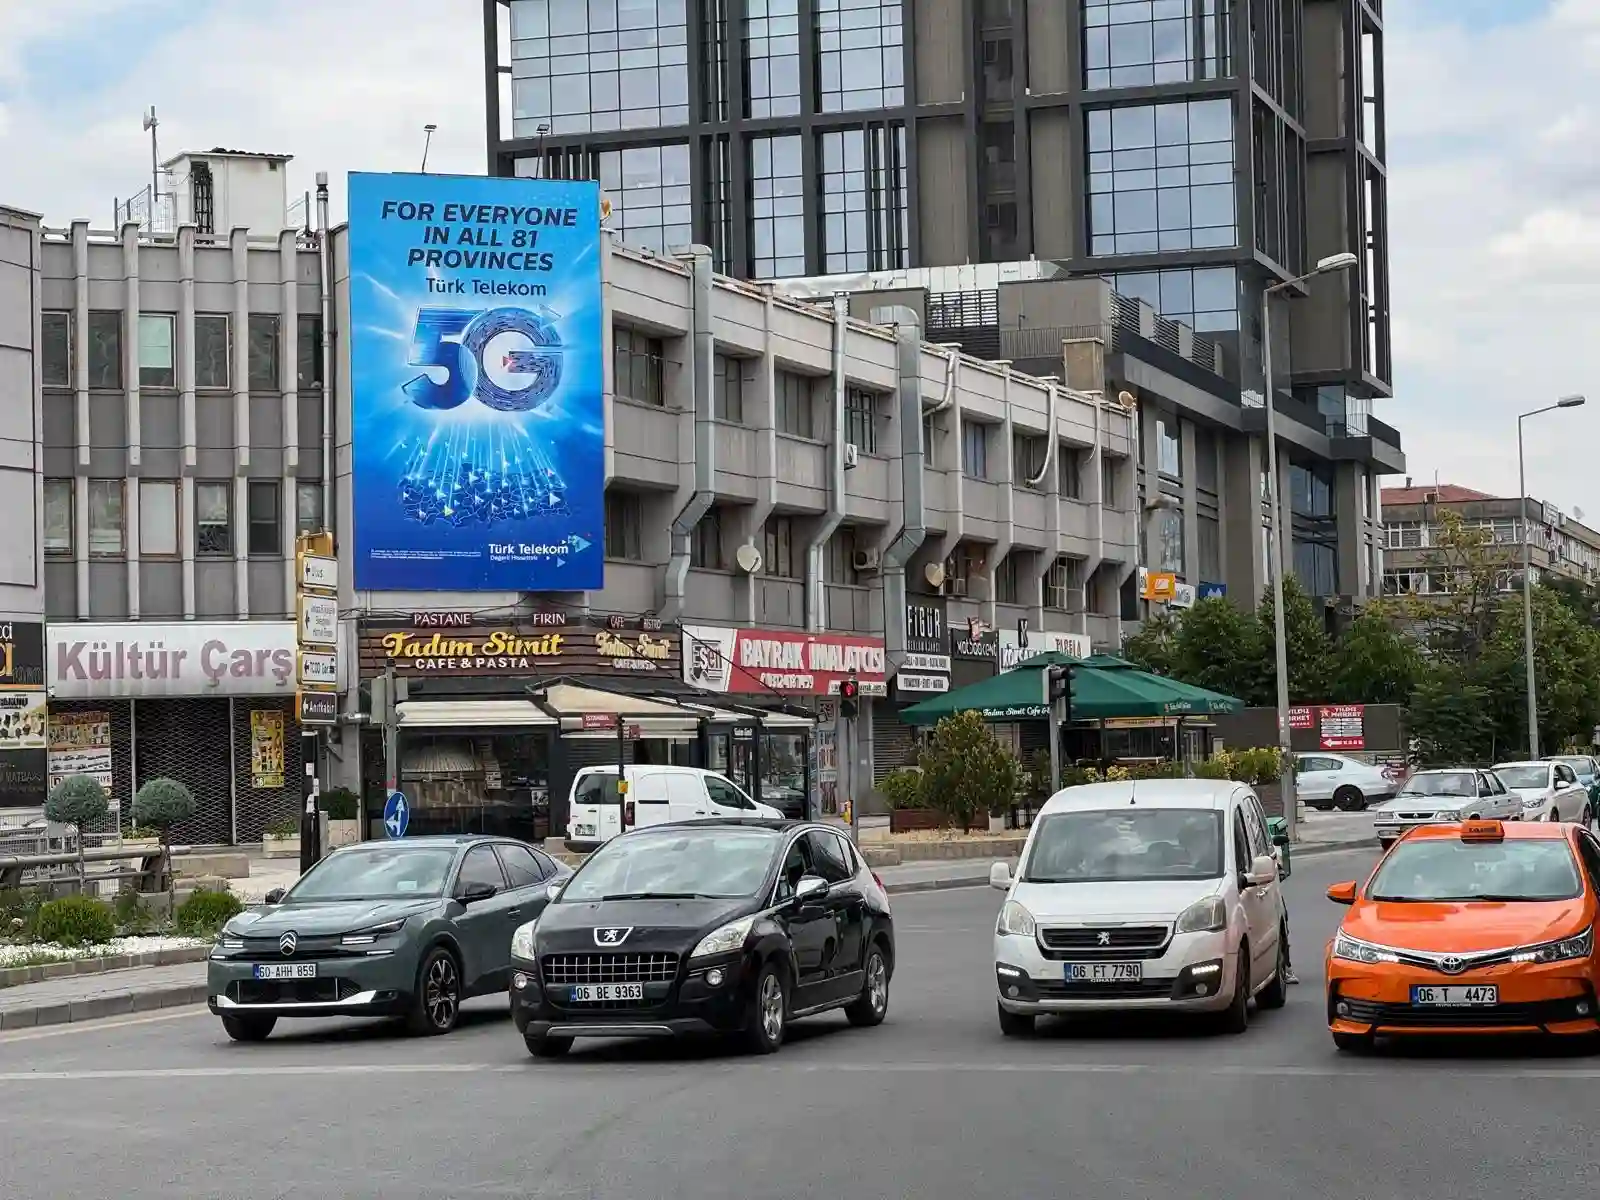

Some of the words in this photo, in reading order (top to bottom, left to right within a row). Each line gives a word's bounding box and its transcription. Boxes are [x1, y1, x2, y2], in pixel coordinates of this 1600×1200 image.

[381, 201, 434, 220] FOR
[443, 204, 578, 226] EVERYONE
[423, 226, 450, 245] IN
[457, 228, 504, 247] ALL
[511, 229, 539, 248] 81
[407, 248, 554, 271] PROVINCES
[425, 277, 465, 294] Türk
[472, 279, 547, 296] Telekom
[402, 306, 564, 412] 5G
[488, 543, 515, 554] Türk
[519, 543, 569, 554] Telekom
[413, 613, 472, 625] PASTANE
[533, 612, 566, 624] FIRIN
[610, 615, 625, 628] CAFE
[381, 631, 476, 657] Tadım
[482, 631, 565, 656] Simit
[57, 638, 188, 681] Kültür
[200, 639, 293, 687] Çarş
[415, 658, 457, 669] CAFE
[460, 658, 472, 669] &
[476, 657, 529, 669] PASTA
[740, 638, 804, 670] BAYRAK
[1072, 965, 1086, 977] 06
[1093, 965, 1107, 978] FT
[1112, 964, 1139, 977] 7790
[577, 987, 590, 999] 06
[615, 985, 641, 998] 9363
[1419, 988, 1434, 1001] 06
[1441, 988, 1450, 1002] T
[1465, 987, 1495, 1001] 4473
